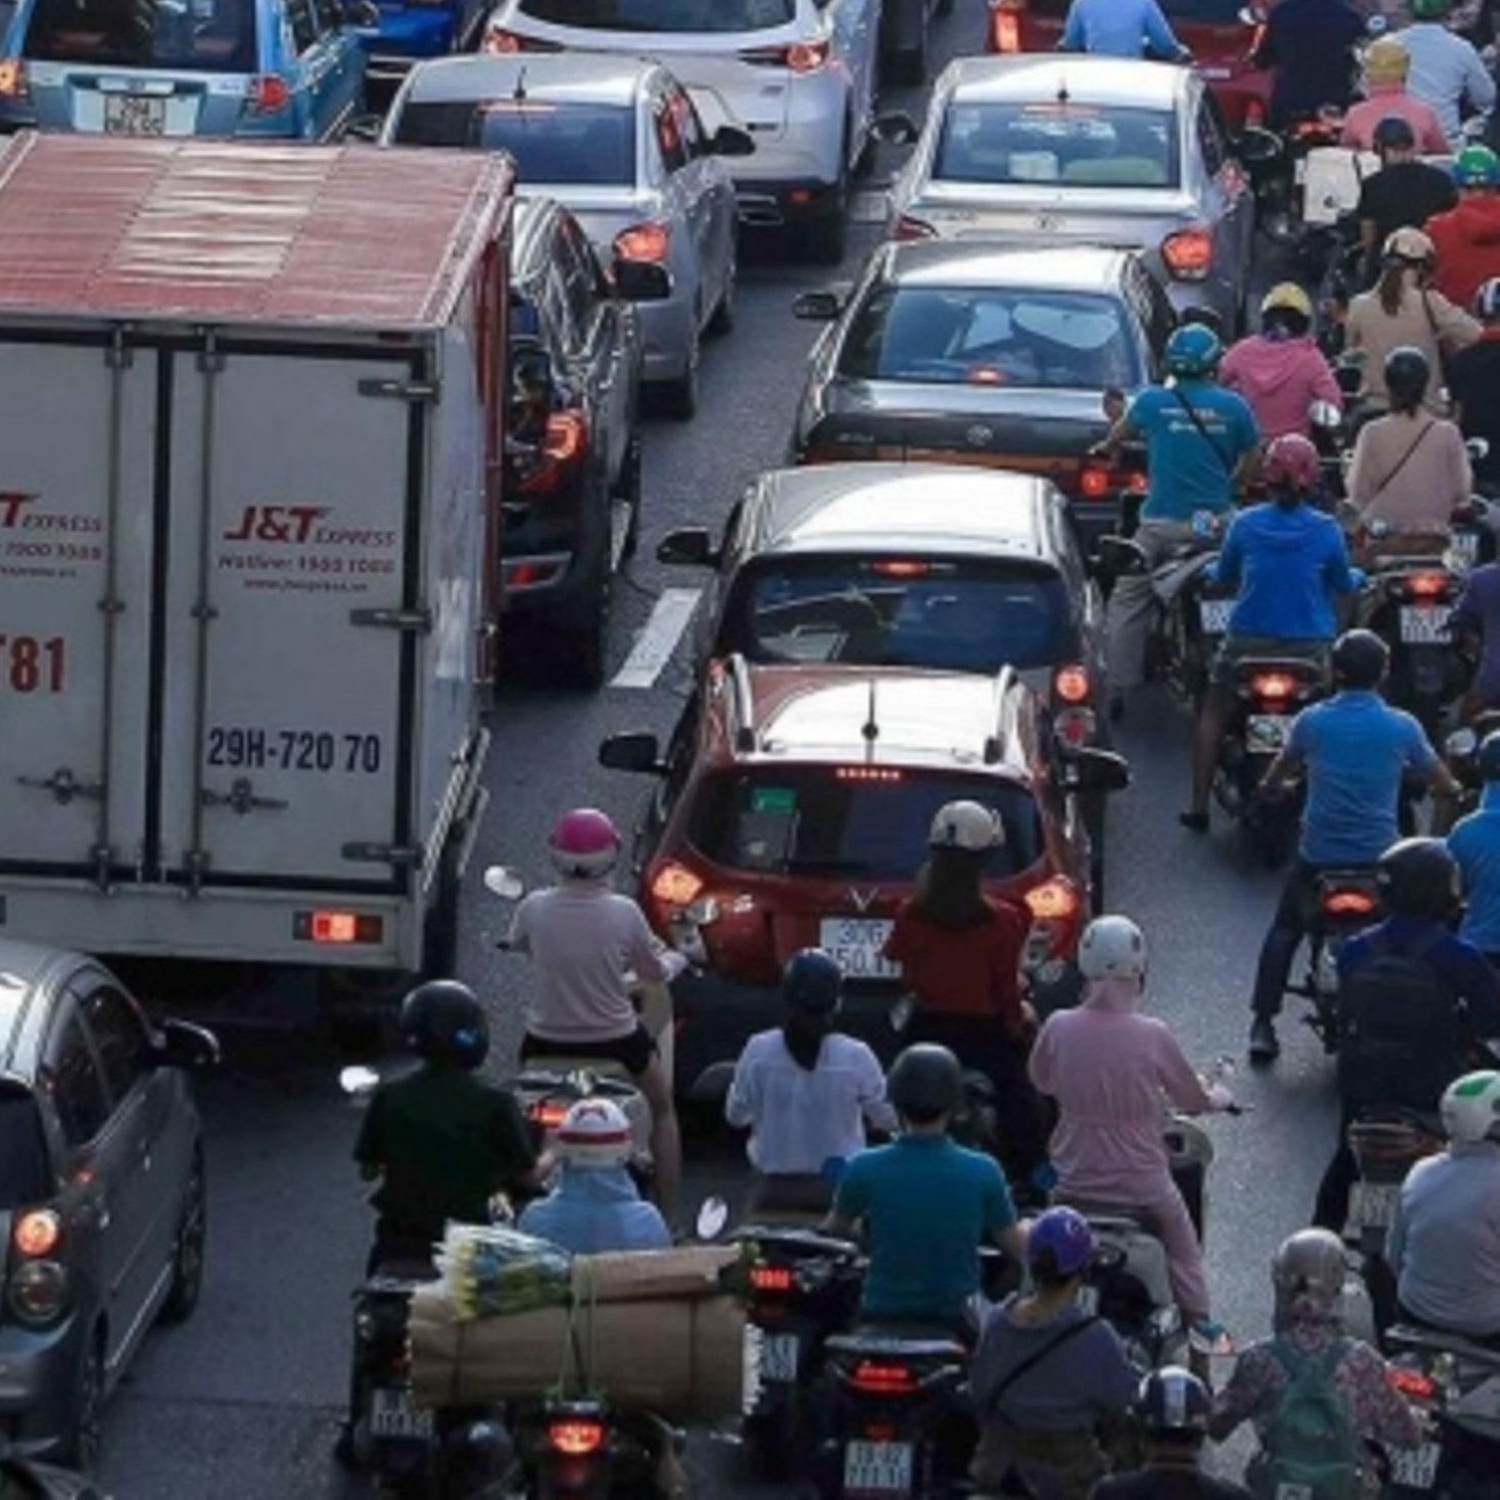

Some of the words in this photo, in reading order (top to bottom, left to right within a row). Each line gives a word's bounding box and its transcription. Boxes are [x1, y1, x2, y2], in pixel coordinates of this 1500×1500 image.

[21, 514, 103, 533] EXPRESS
[223, 505, 334, 544] J&T
[314, 528, 396, 548] EXPRESS
[206, 726, 335, 772] 29H-720
[343, 733, 382, 774] 70
